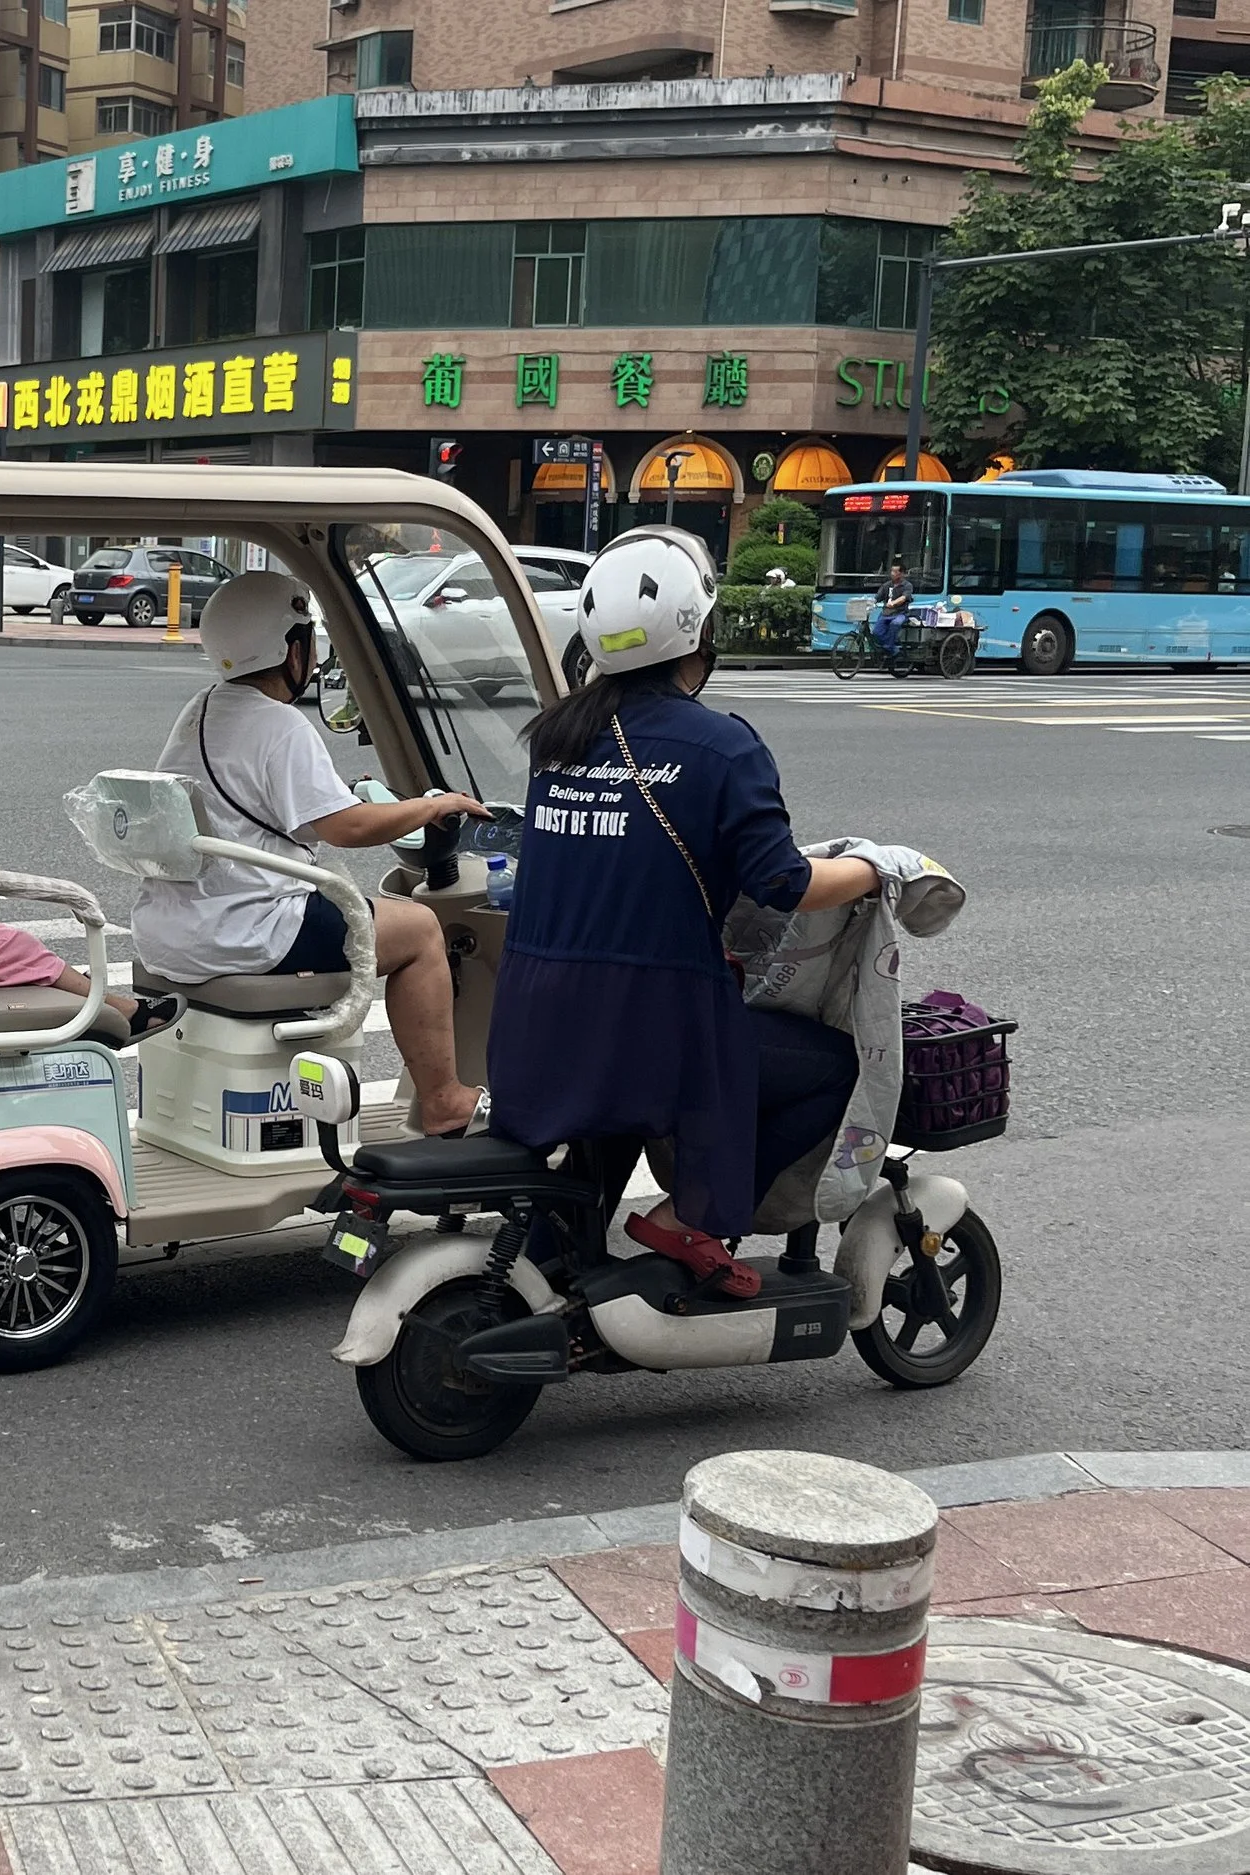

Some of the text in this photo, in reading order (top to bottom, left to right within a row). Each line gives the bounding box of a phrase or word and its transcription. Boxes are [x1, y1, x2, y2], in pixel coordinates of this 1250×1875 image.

[118, 172, 211, 202] ENJOY FITNESS
[13, 351, 298, 430] 西北戎鼎烟酒直营
[421, 351, 749, 410] 葡國餐廳
[548, 785, 623, 803] Believe me
[534, 804, 629, 836] MUST BE TRUE
[299, 1079, 324, 1101] 爱玛
